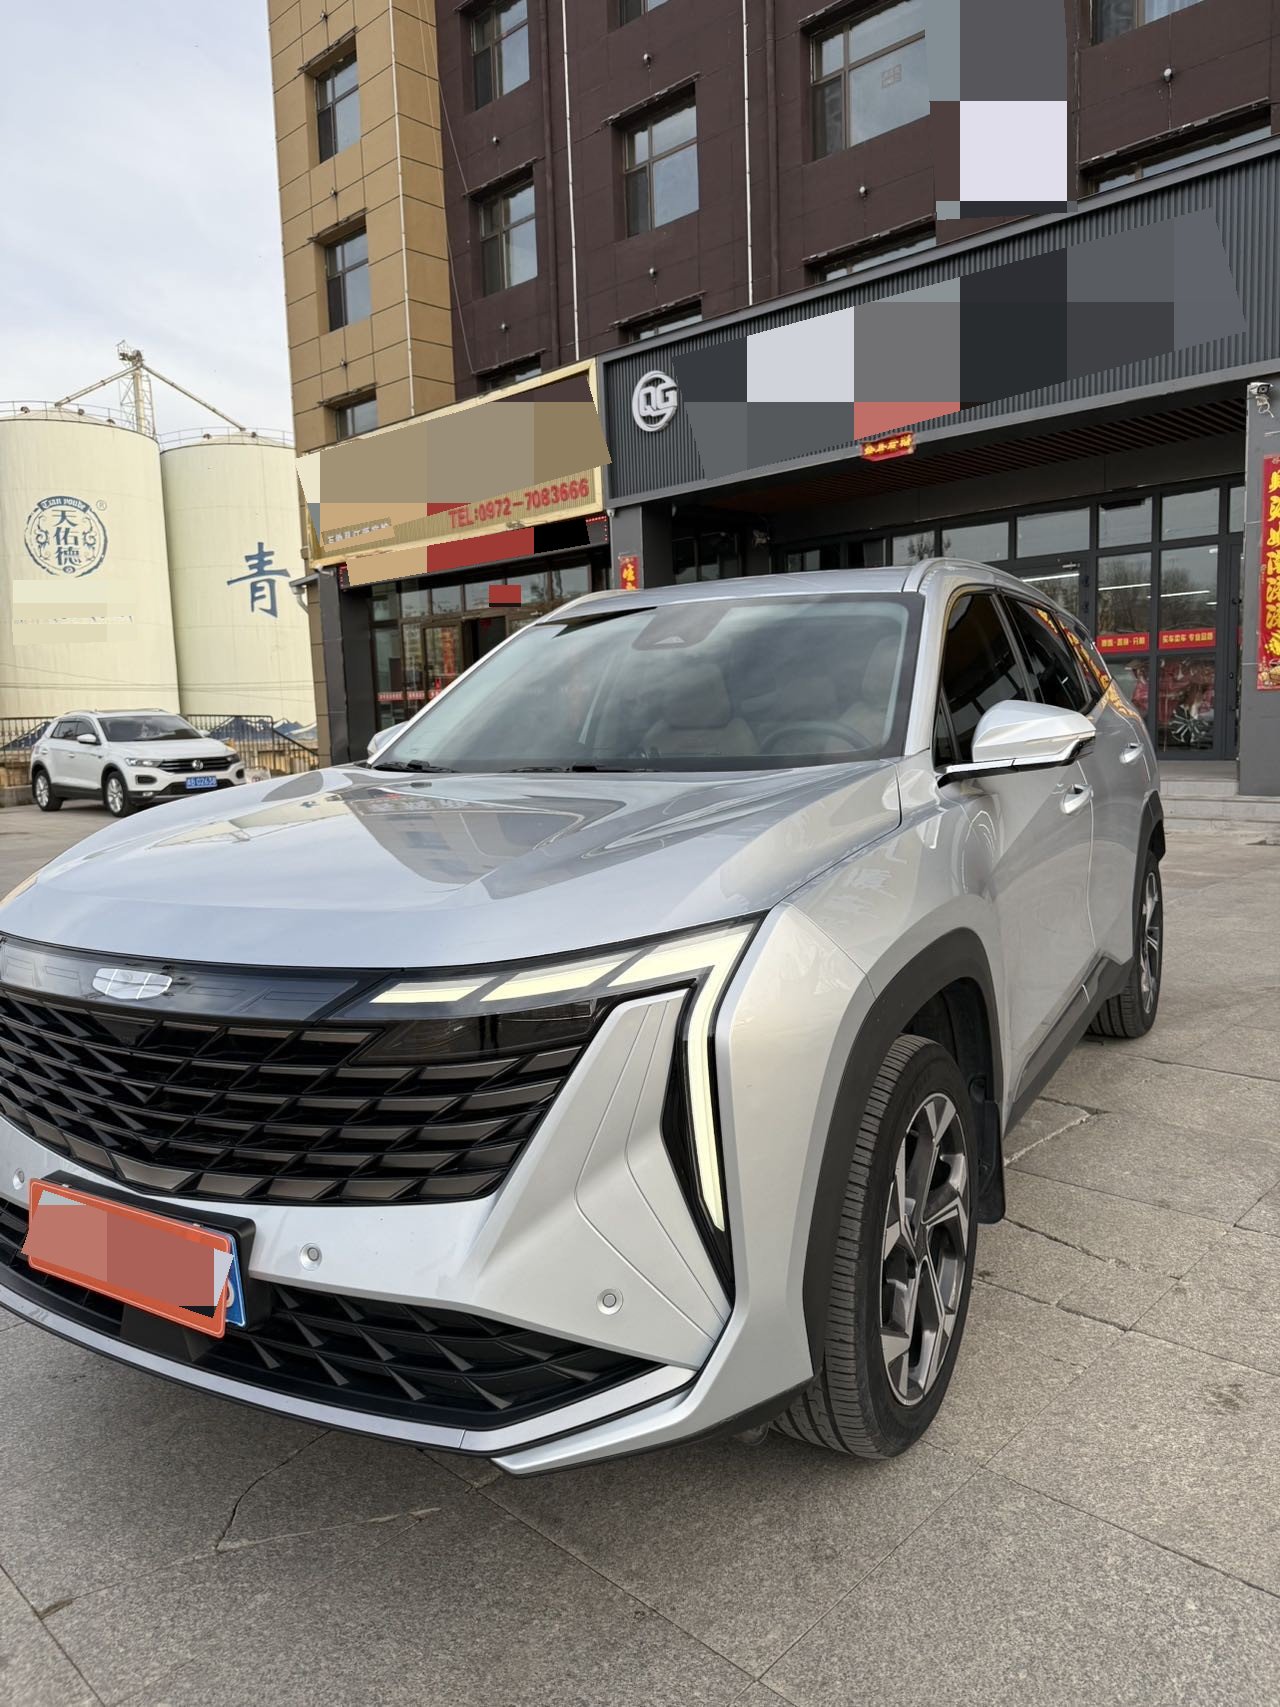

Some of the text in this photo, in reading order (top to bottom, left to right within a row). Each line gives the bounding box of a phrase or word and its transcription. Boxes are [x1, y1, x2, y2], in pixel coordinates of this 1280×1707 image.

[52, 509, 82, 567] 天佑德
[227, 541, 291, 618] 青
